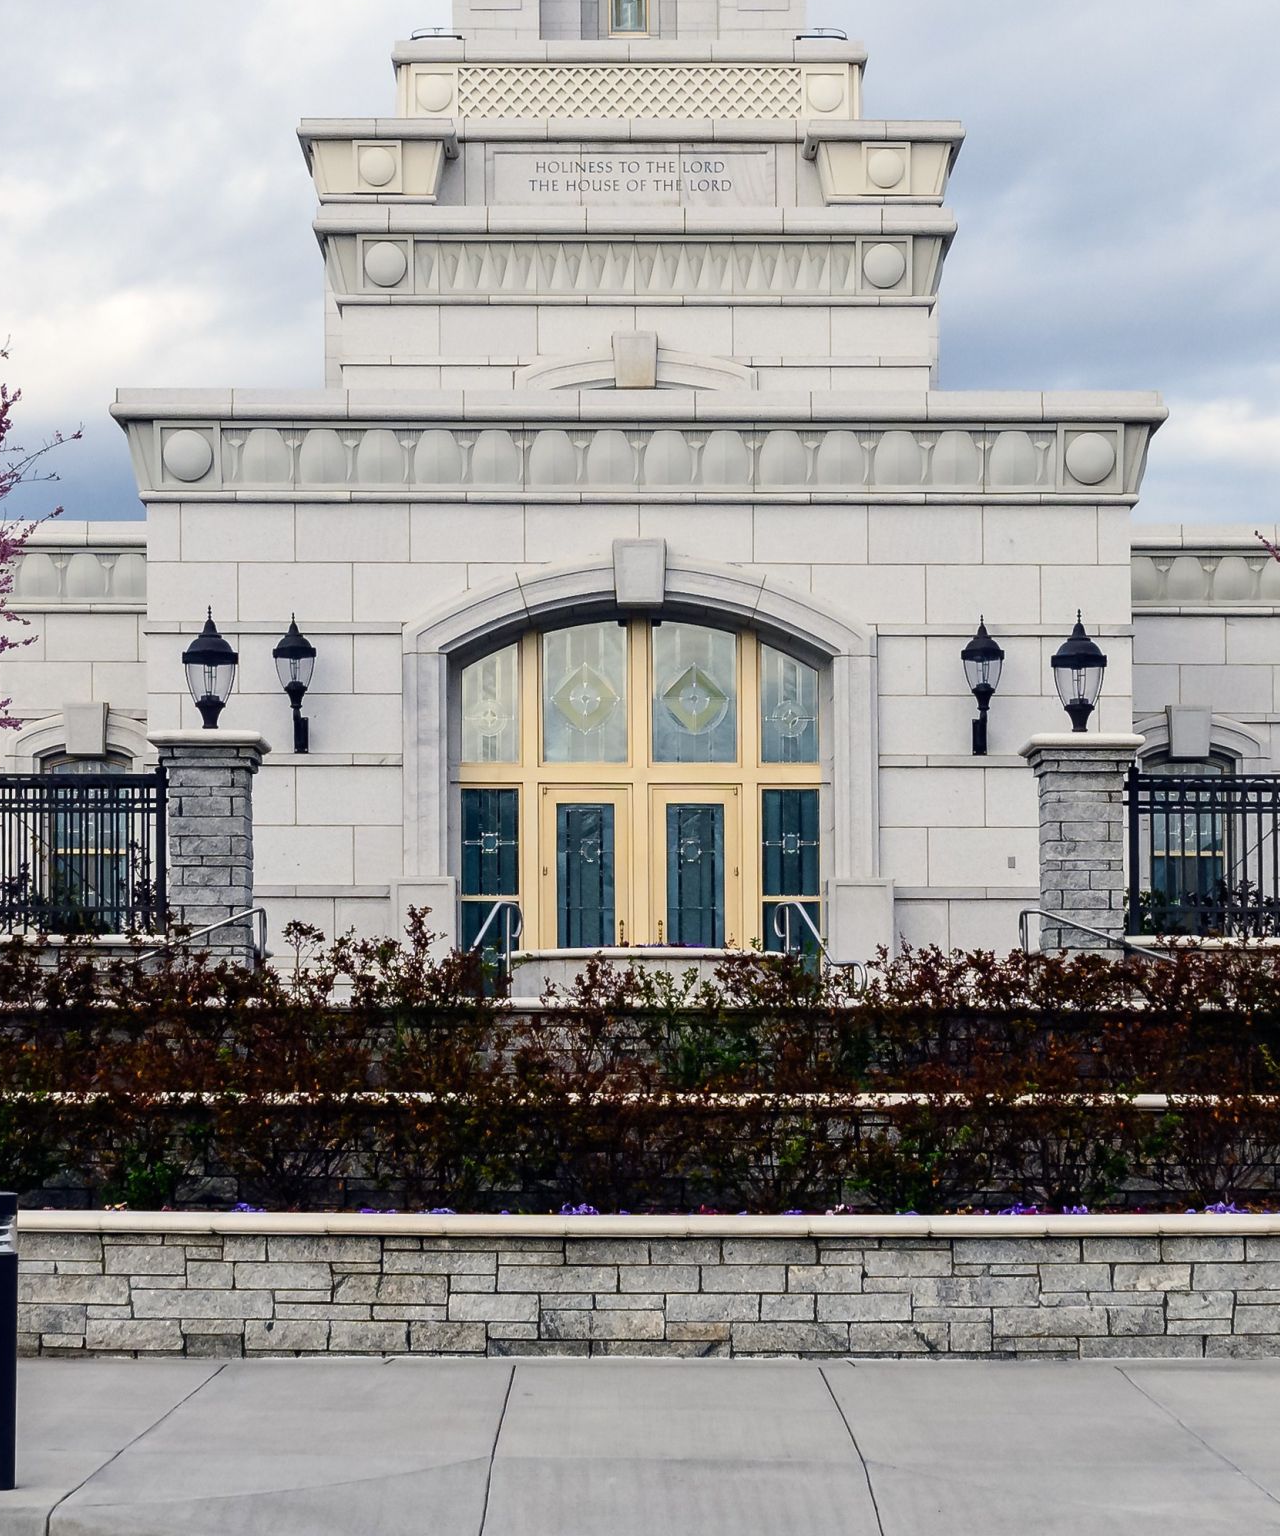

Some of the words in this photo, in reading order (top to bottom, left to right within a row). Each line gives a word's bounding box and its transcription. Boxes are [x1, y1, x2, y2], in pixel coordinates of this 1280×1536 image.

[535, 161, 613, 173] HOLINESS
[619, 161, 640, 173] TO
[646, 161, 675, 173] THE
[683, 161, 725, 173] LORD
[528, 179, 559, 192] THE
[566, 179, 620, 192] HOUSE
[626, 179, 647, 192] OF
[653, 179, 682, 192] THE
[690, 179, 732, 192] LORD
